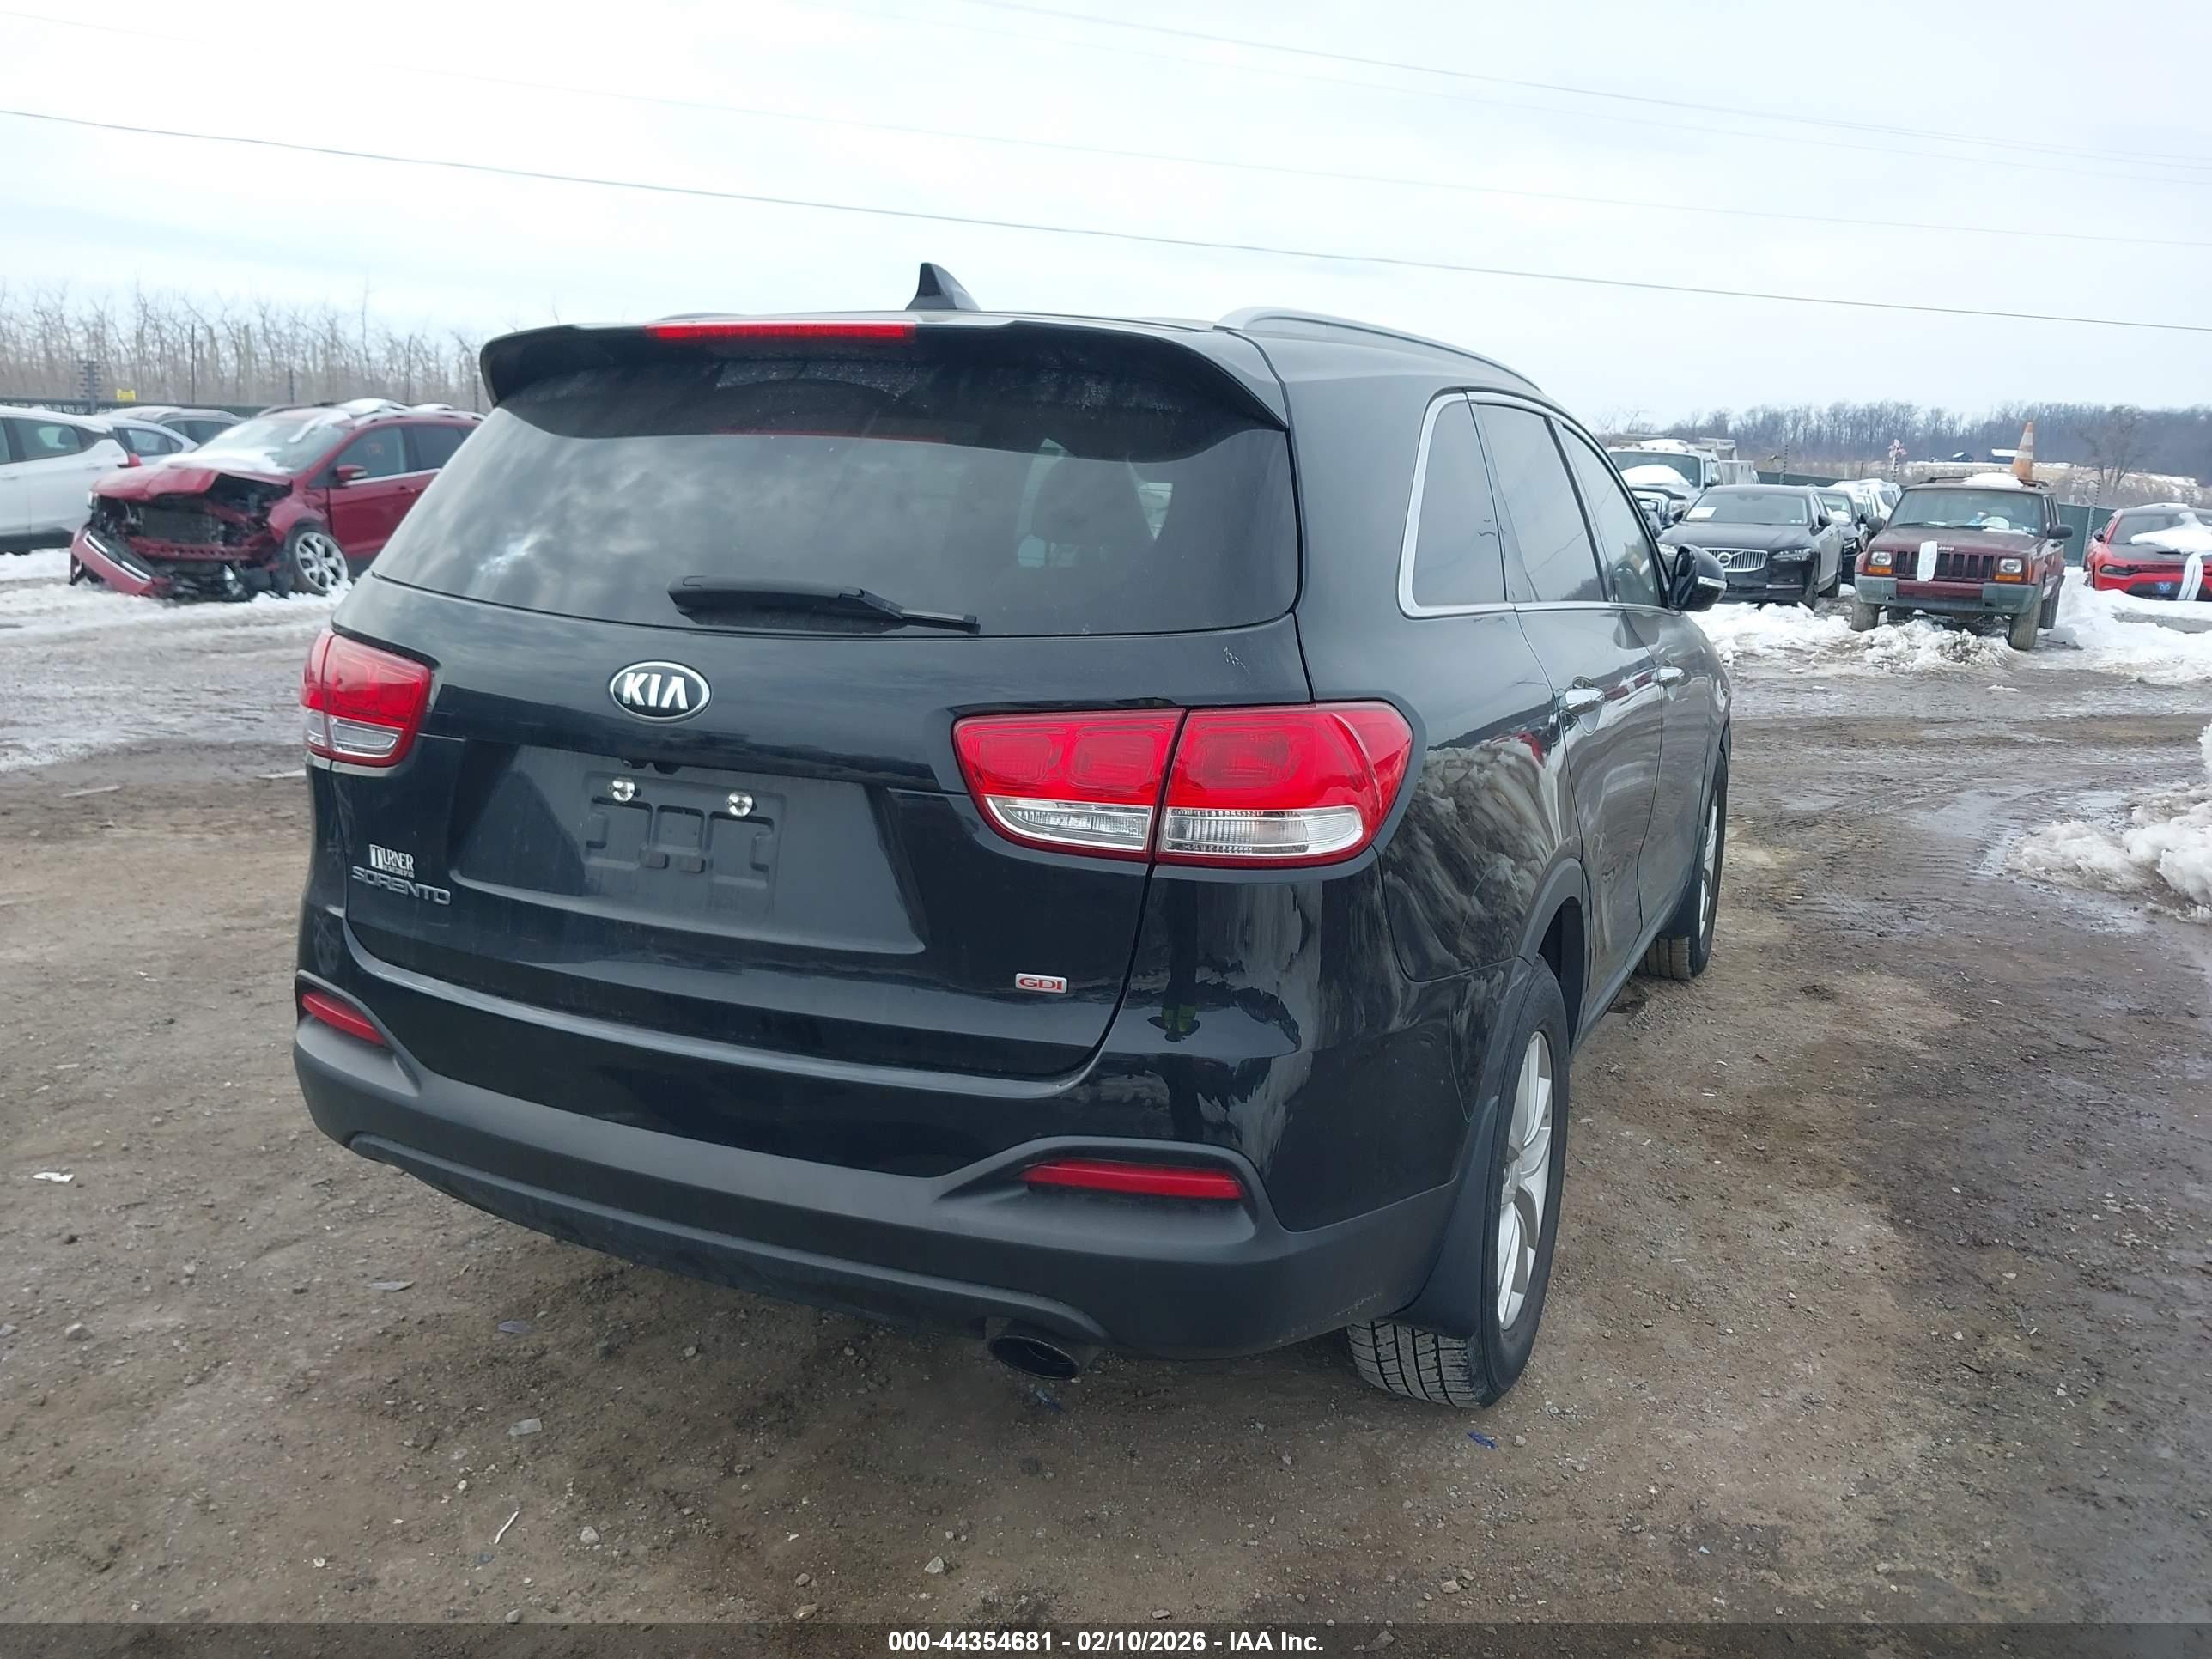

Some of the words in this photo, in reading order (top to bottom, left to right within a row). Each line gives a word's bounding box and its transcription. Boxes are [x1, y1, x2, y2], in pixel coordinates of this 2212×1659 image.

[623, 672, 689, 710] KIA
[369, 843, 414, 872] TURNER
[352, 866, 451, 905] SORENTO
[1019, 977, 1062, 990] GDI
